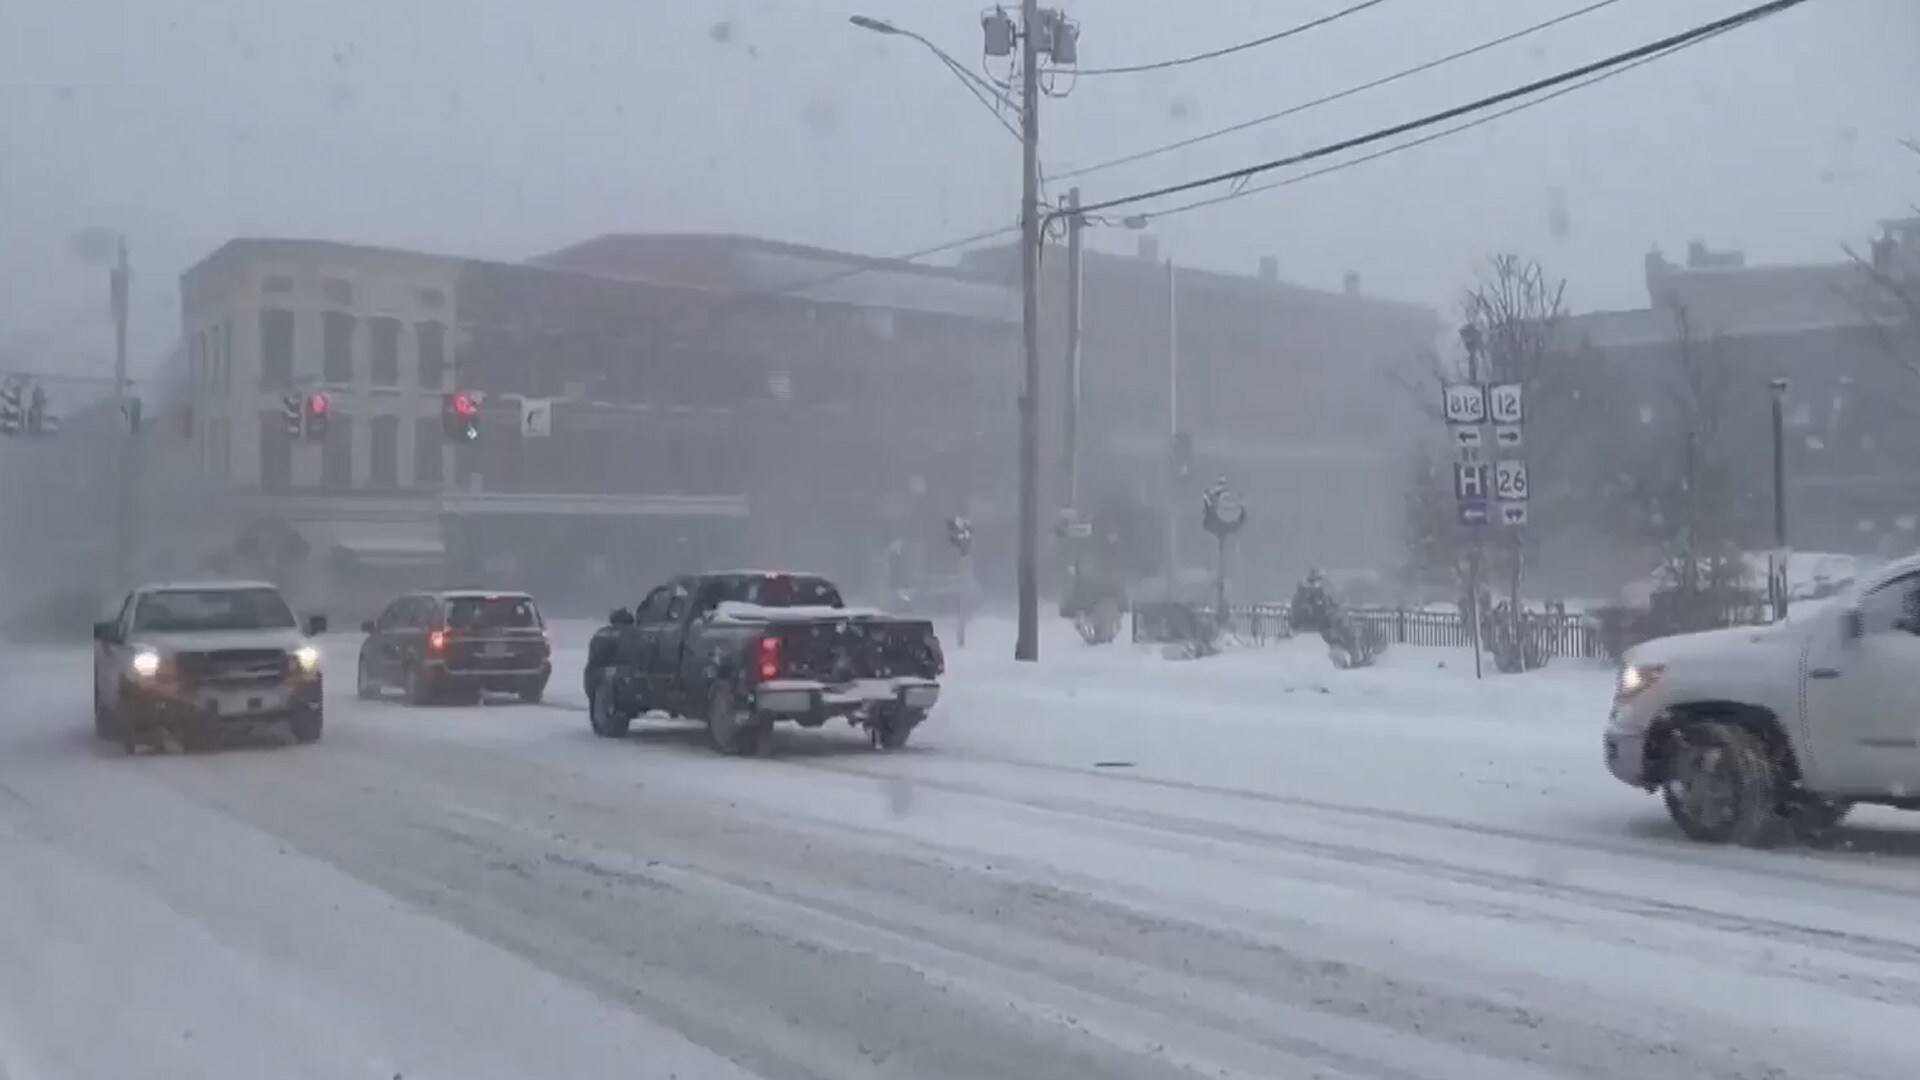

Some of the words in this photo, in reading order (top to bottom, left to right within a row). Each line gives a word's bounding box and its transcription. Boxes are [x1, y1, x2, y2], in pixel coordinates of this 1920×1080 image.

[1450, 395, 1481, 414] 812
[1497, 393, 1518, 415] 12
[1460, 468, 1481, 495] H
[1499, 470, 1525, 492] 26
